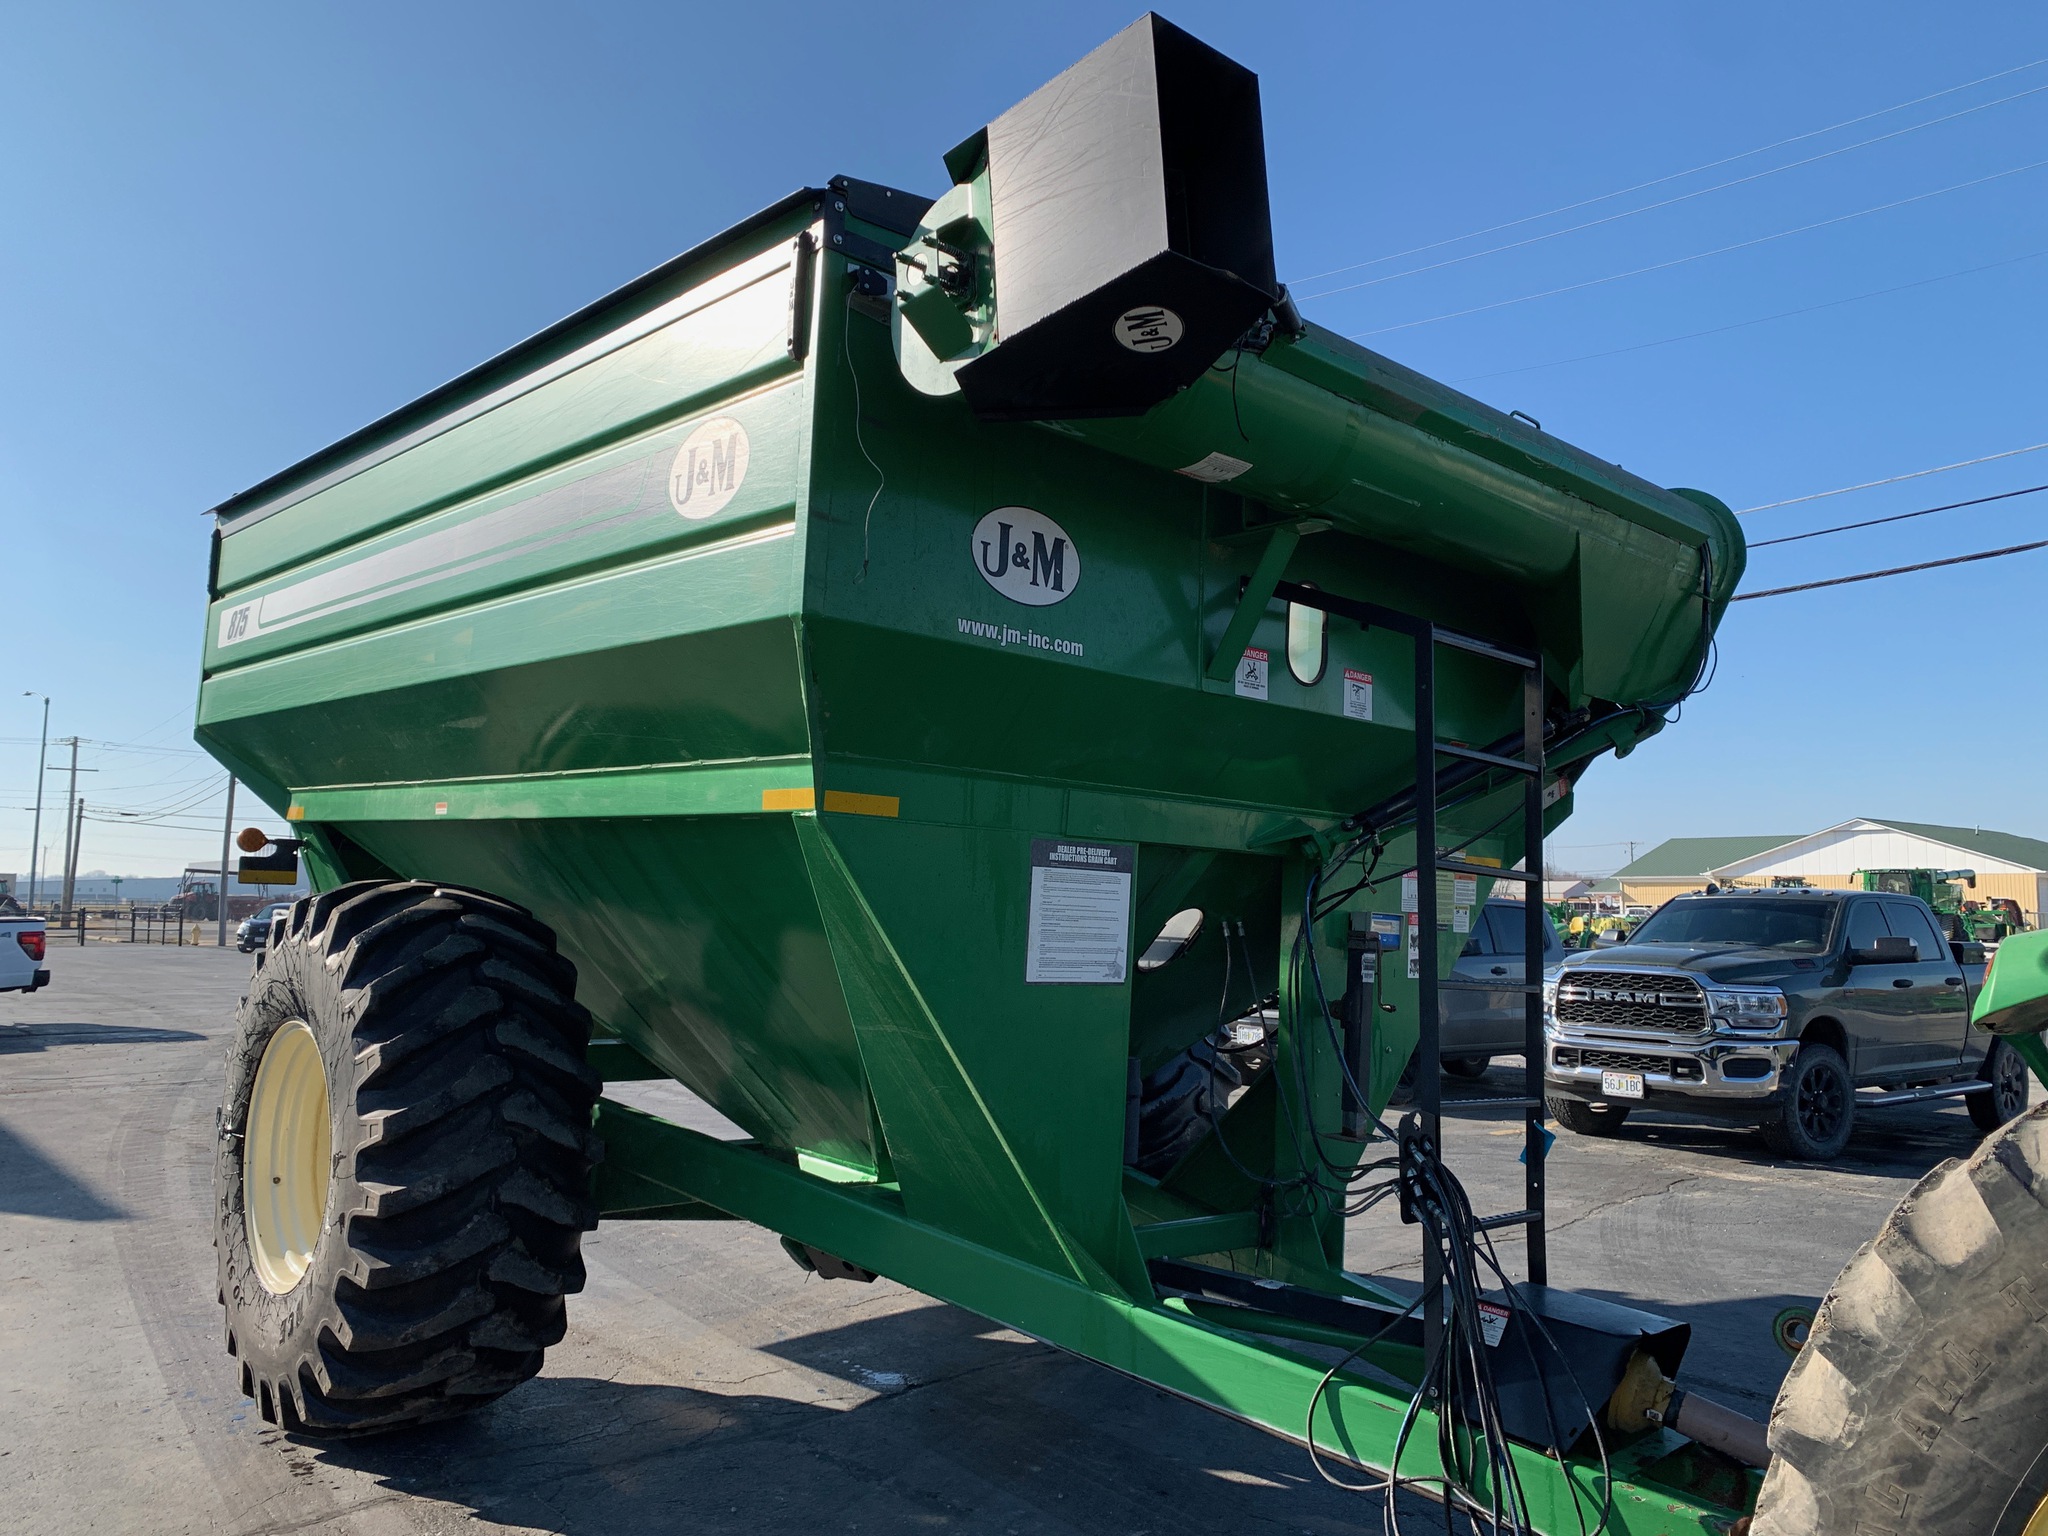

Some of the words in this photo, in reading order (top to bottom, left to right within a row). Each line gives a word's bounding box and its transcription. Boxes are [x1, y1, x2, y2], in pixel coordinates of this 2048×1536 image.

[1123, 309, 1173, 350] J&M
[675, 432, 739, 505] J&M
[980, 521, 1067, 593] J&M
[227, 605, 251, 641] 875
[957, 617, 1084, 657] www.jm-inc.com
[1349, 671, 1372, 682] DANGER
[1049, 852, 1087, 863] INSTRUCTIONS
[1088, 855, 1103, 864] GRAIN
[1104, 857, 1117, 865] CART
[1057, 845, 1076, 854] DEALER
[1076, 846, 1111, 857] PRE-DELIVERY
[1594, 991, 1656, 1003] RAM
[1483, 1305, 1508, 1317] DANGER
